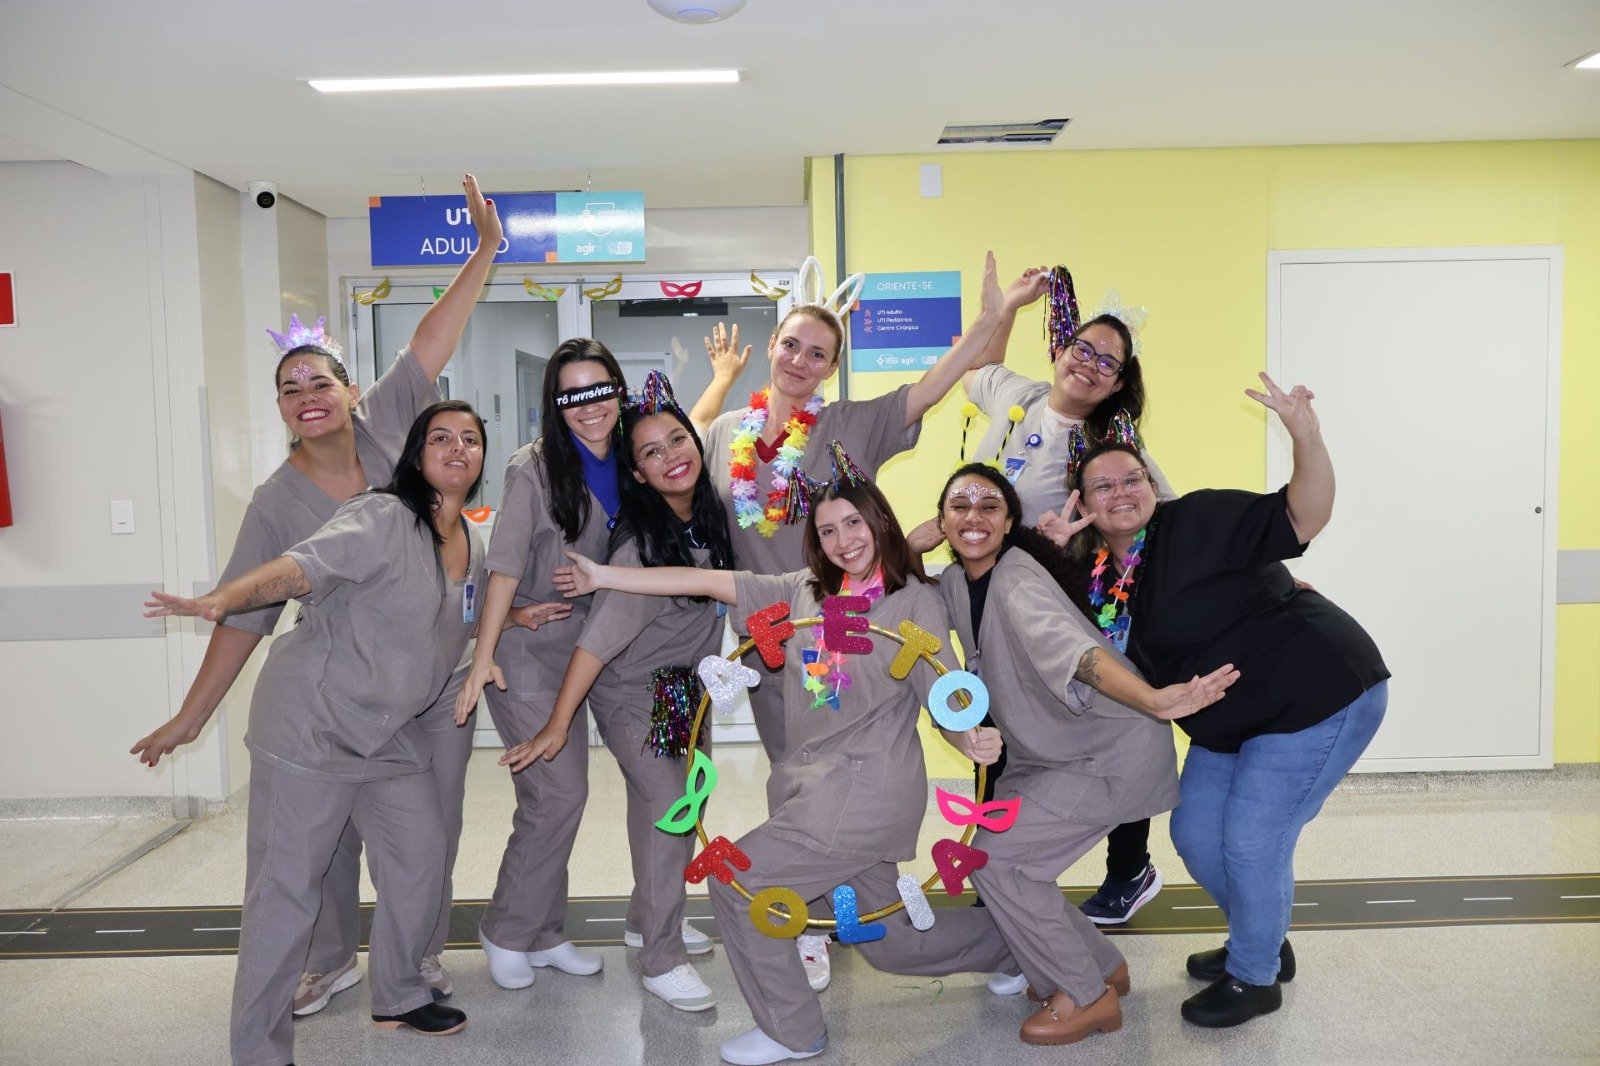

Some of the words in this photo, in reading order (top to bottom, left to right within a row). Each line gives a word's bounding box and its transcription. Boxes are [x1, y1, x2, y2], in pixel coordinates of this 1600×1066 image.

[420, 237, 509, 255] ADULO
[576, 241, 596, 256] agir
[877, 281, 934, 292] ORIENTE-SE
[556, 394, 569, 406] TÔ
[571, 385, 614, 402] INVISÍVEL
